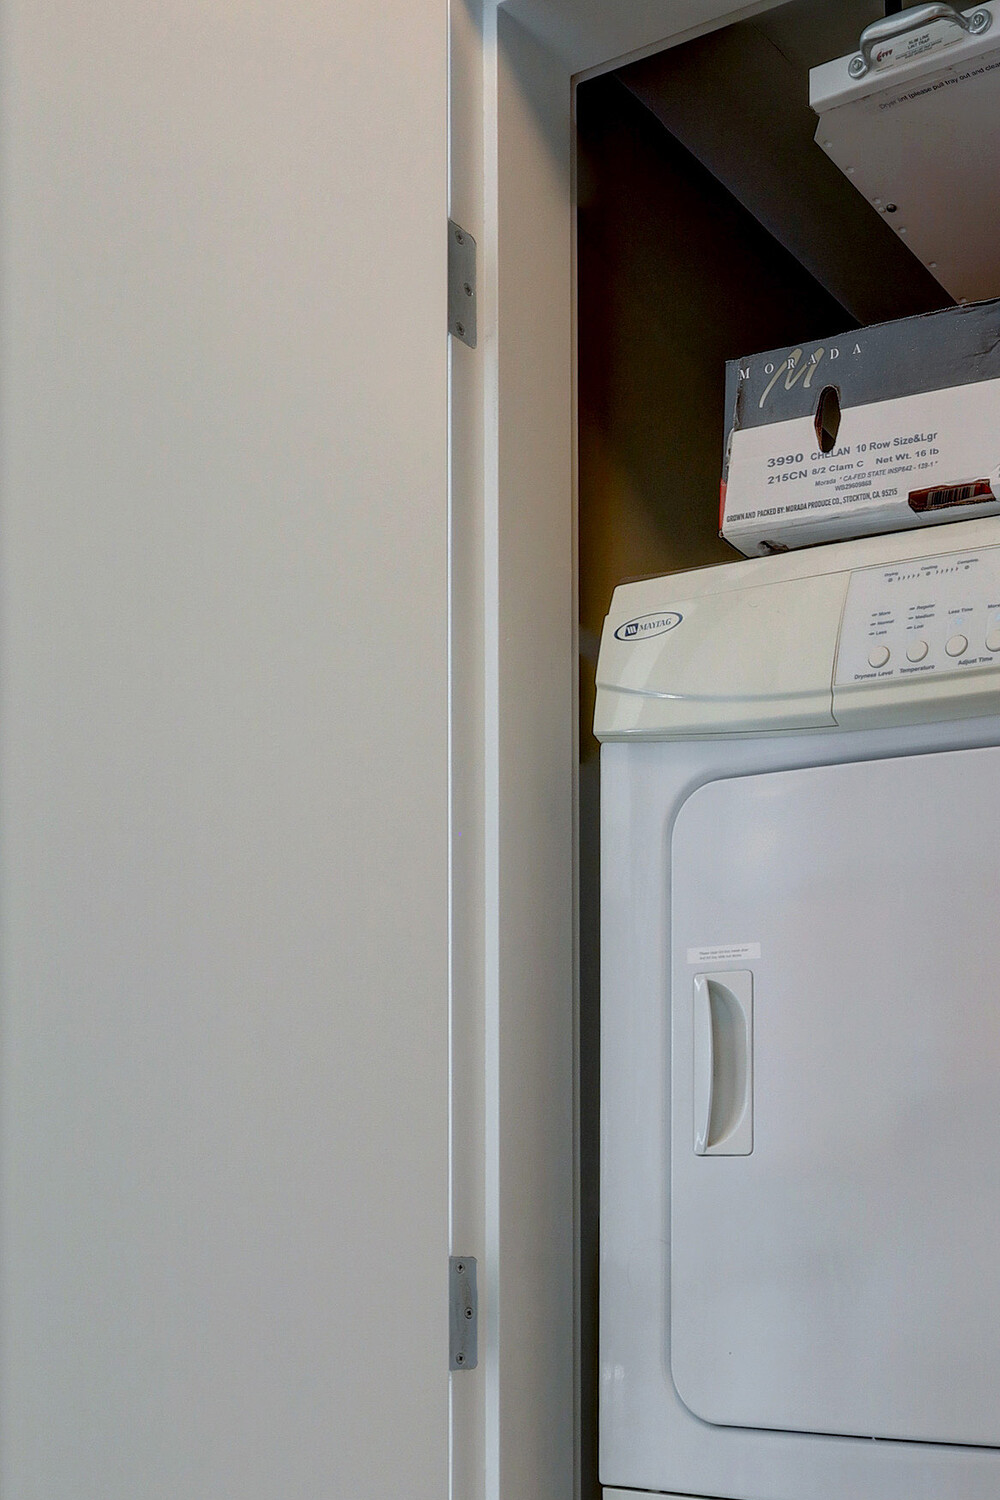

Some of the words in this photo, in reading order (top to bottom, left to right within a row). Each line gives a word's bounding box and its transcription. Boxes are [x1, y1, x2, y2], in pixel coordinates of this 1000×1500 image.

[945, 77, 958, 86] tray
[960, 72, 971, 80] out
[972, 67, 984, 76] and
[739, 343, 862, 380] MORADA
[767, 452, 804, 468] 3990
[856, 444, 867, 453] 10
[869, 441, 891, 451] Row
[893, 432, 938, 446] Size&Lgr
[767, 470, 808, 485] 215CN
[812, 466, 826, 476] 8/2
[828, 463, 854, 472] Clam
[856, 460, 864, 468] C
[876, 456, 893, 465] Net
[895, 452, 912, 461] Wt.
[915, 449, 927, 458] 16
[929, 448, 940, 456] lb
[867, 468, 886, 478] STATE
[745, 511, 756, 520] AND
[756, 508, 776, 518] PACKED
[786, 502, 808, 512] MORADA
[808, 498, 832, 509] PRODUCE
[882, 488, 898, 498] 95215
[638, 618, 672, 632] MAYTAG
[854, 672, 877, 680] Dryness
[900, 664, 936, 674] Temperature
